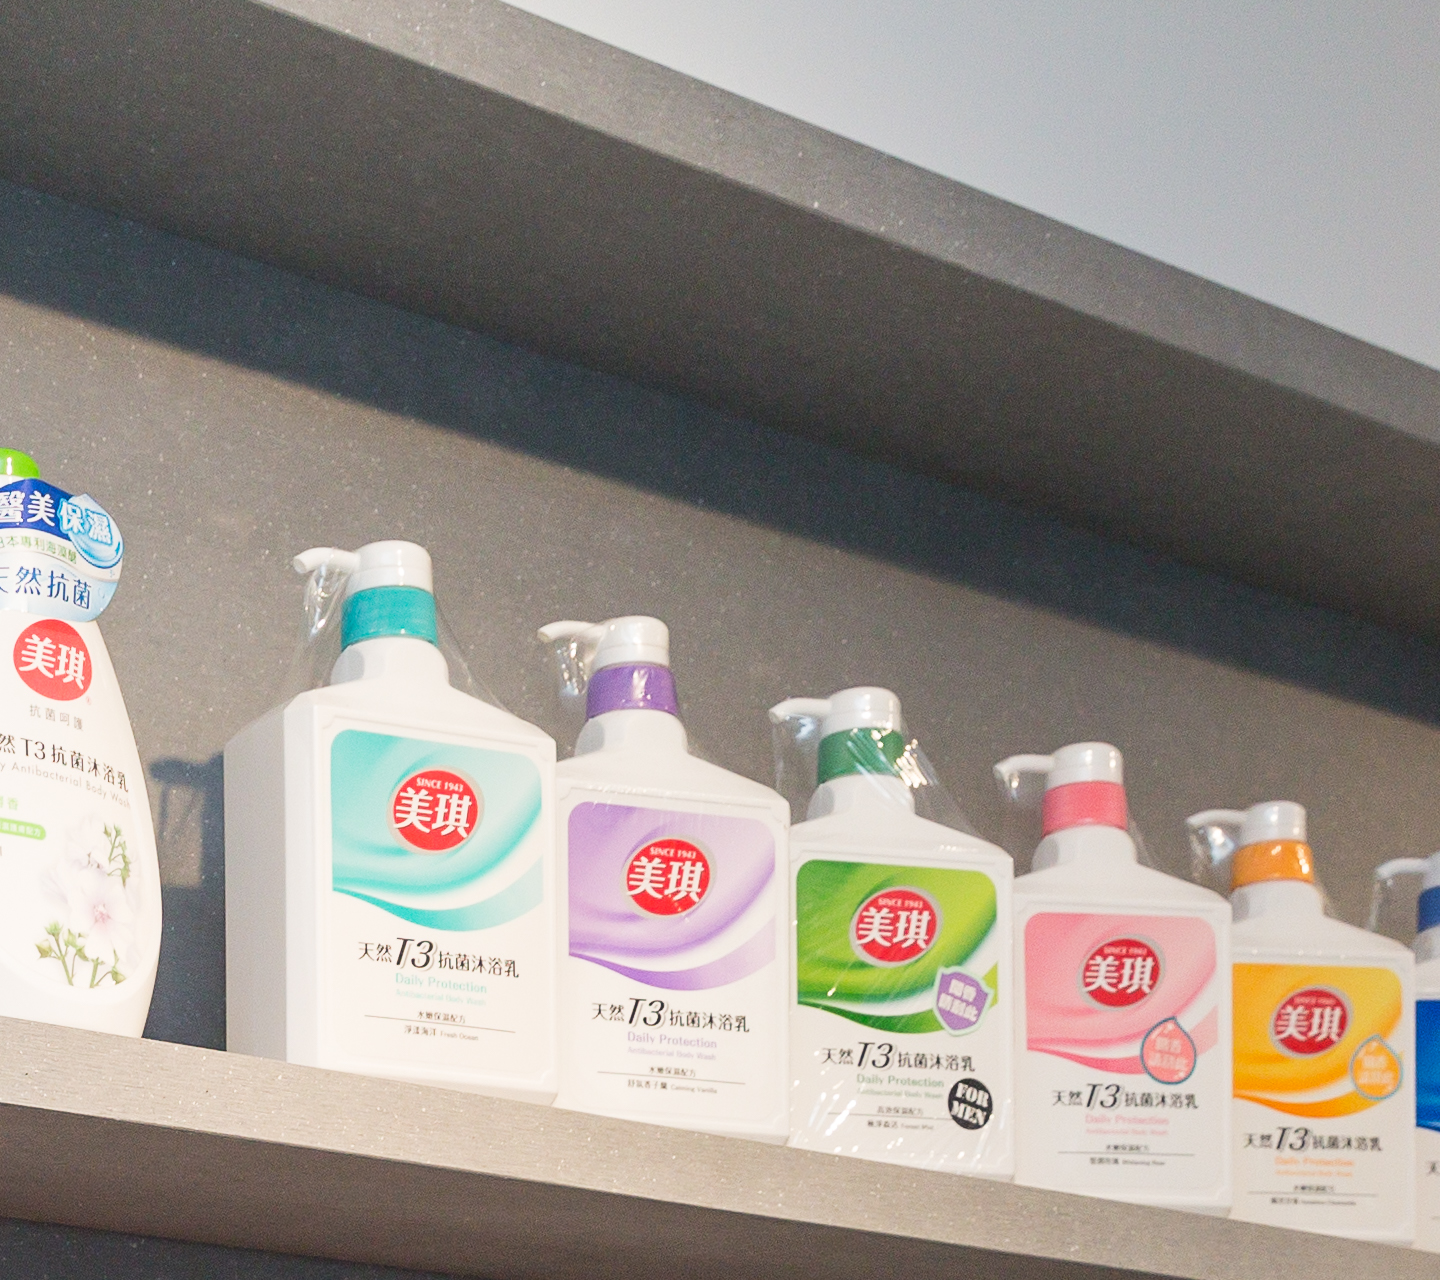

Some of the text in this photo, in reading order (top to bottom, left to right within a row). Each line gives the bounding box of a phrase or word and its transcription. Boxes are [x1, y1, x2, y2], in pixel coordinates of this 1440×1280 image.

[416, 777, 464, 792] SINCE 1943
[627, 856, 705, 903] 美琪
[856, 907, 931, 949] 美琪
[395, 972, 488, 993] Daily Protection
[1084, 956, 1156, 994] 美琪
[1276, 1005, 1342, 1042] 美琪
[627, 1031, 717, 1049] Daily Protection
[956, 1082, 989, 1107] FOR
[951, 1101, 988, 1125] MEN
